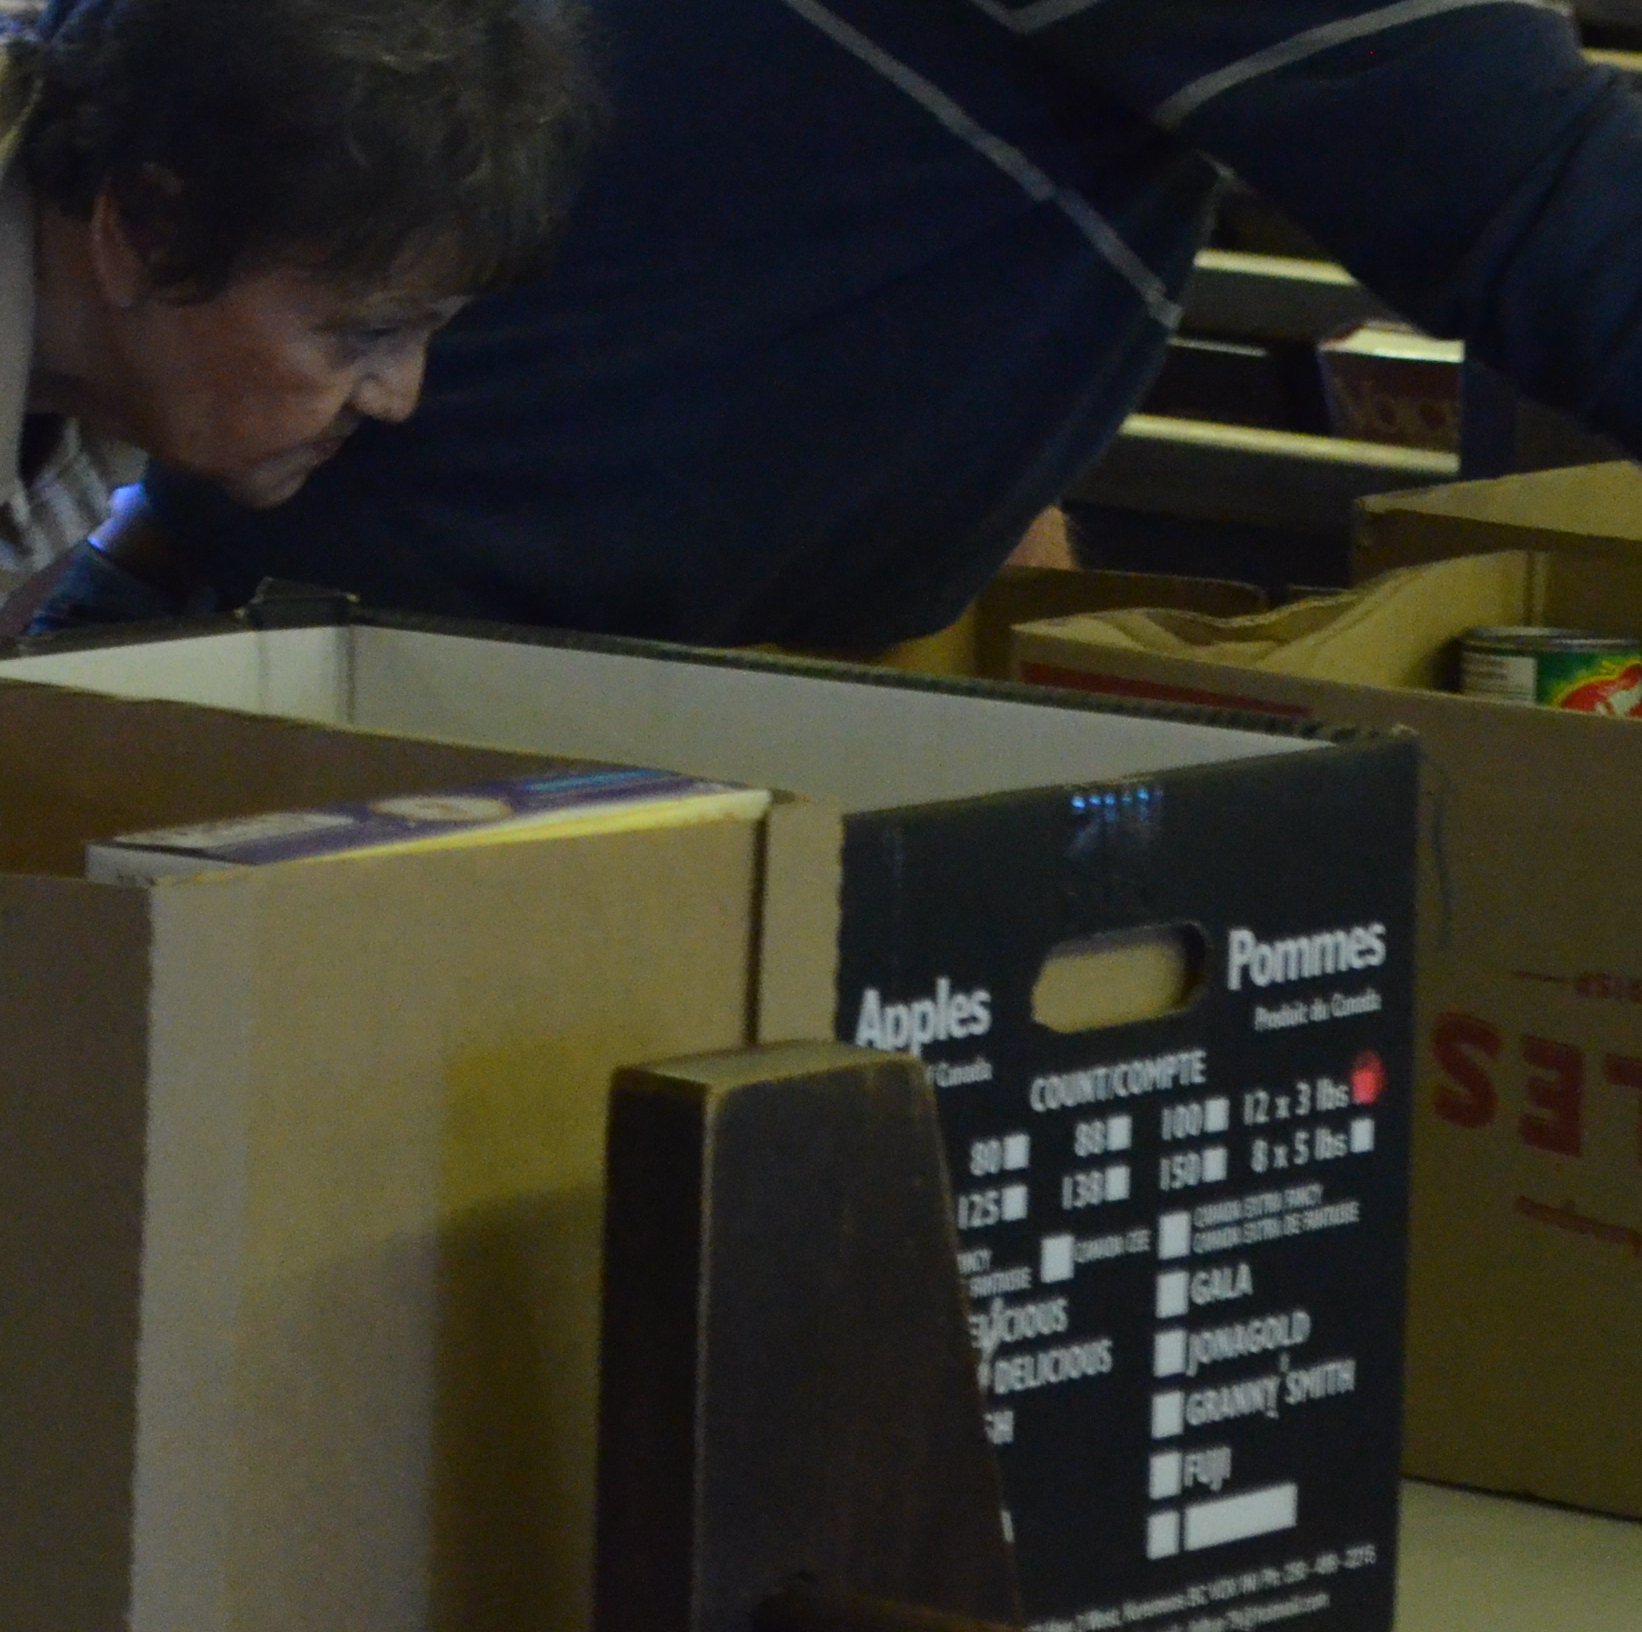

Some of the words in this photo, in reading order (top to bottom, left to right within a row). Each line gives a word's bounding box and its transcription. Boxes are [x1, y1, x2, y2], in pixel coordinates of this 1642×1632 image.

[1225, 920, 1387, 992] Pommes
[854, 975, 994, 1059] Apples
[1028, 1049, 1208, 1114] COUNT/COMPTE
[1295, 1079, 1312, 1117] 3
[1315, 1076, 1350, 1112] lbs
[1161, 1101, 1203, 1142] 100
[1293, 1129, 1310, 1166] 5
[1313, 1126, 1349, 1162] lbs
[1189, 1260, 1255, 1307] GALA
[969, 1296, 1070, 1349] ELICIOUS
[1184, 1308, 1313, 1378] JONAGOLD
[994, 1336, 1115, 1397] DELICIOUS
[1185, 1374, 1281, 1427] GRANNY
[1283, 1357, 1358, 1407] SMITH
[1183, 1444, 1233, 1493] FUJI
